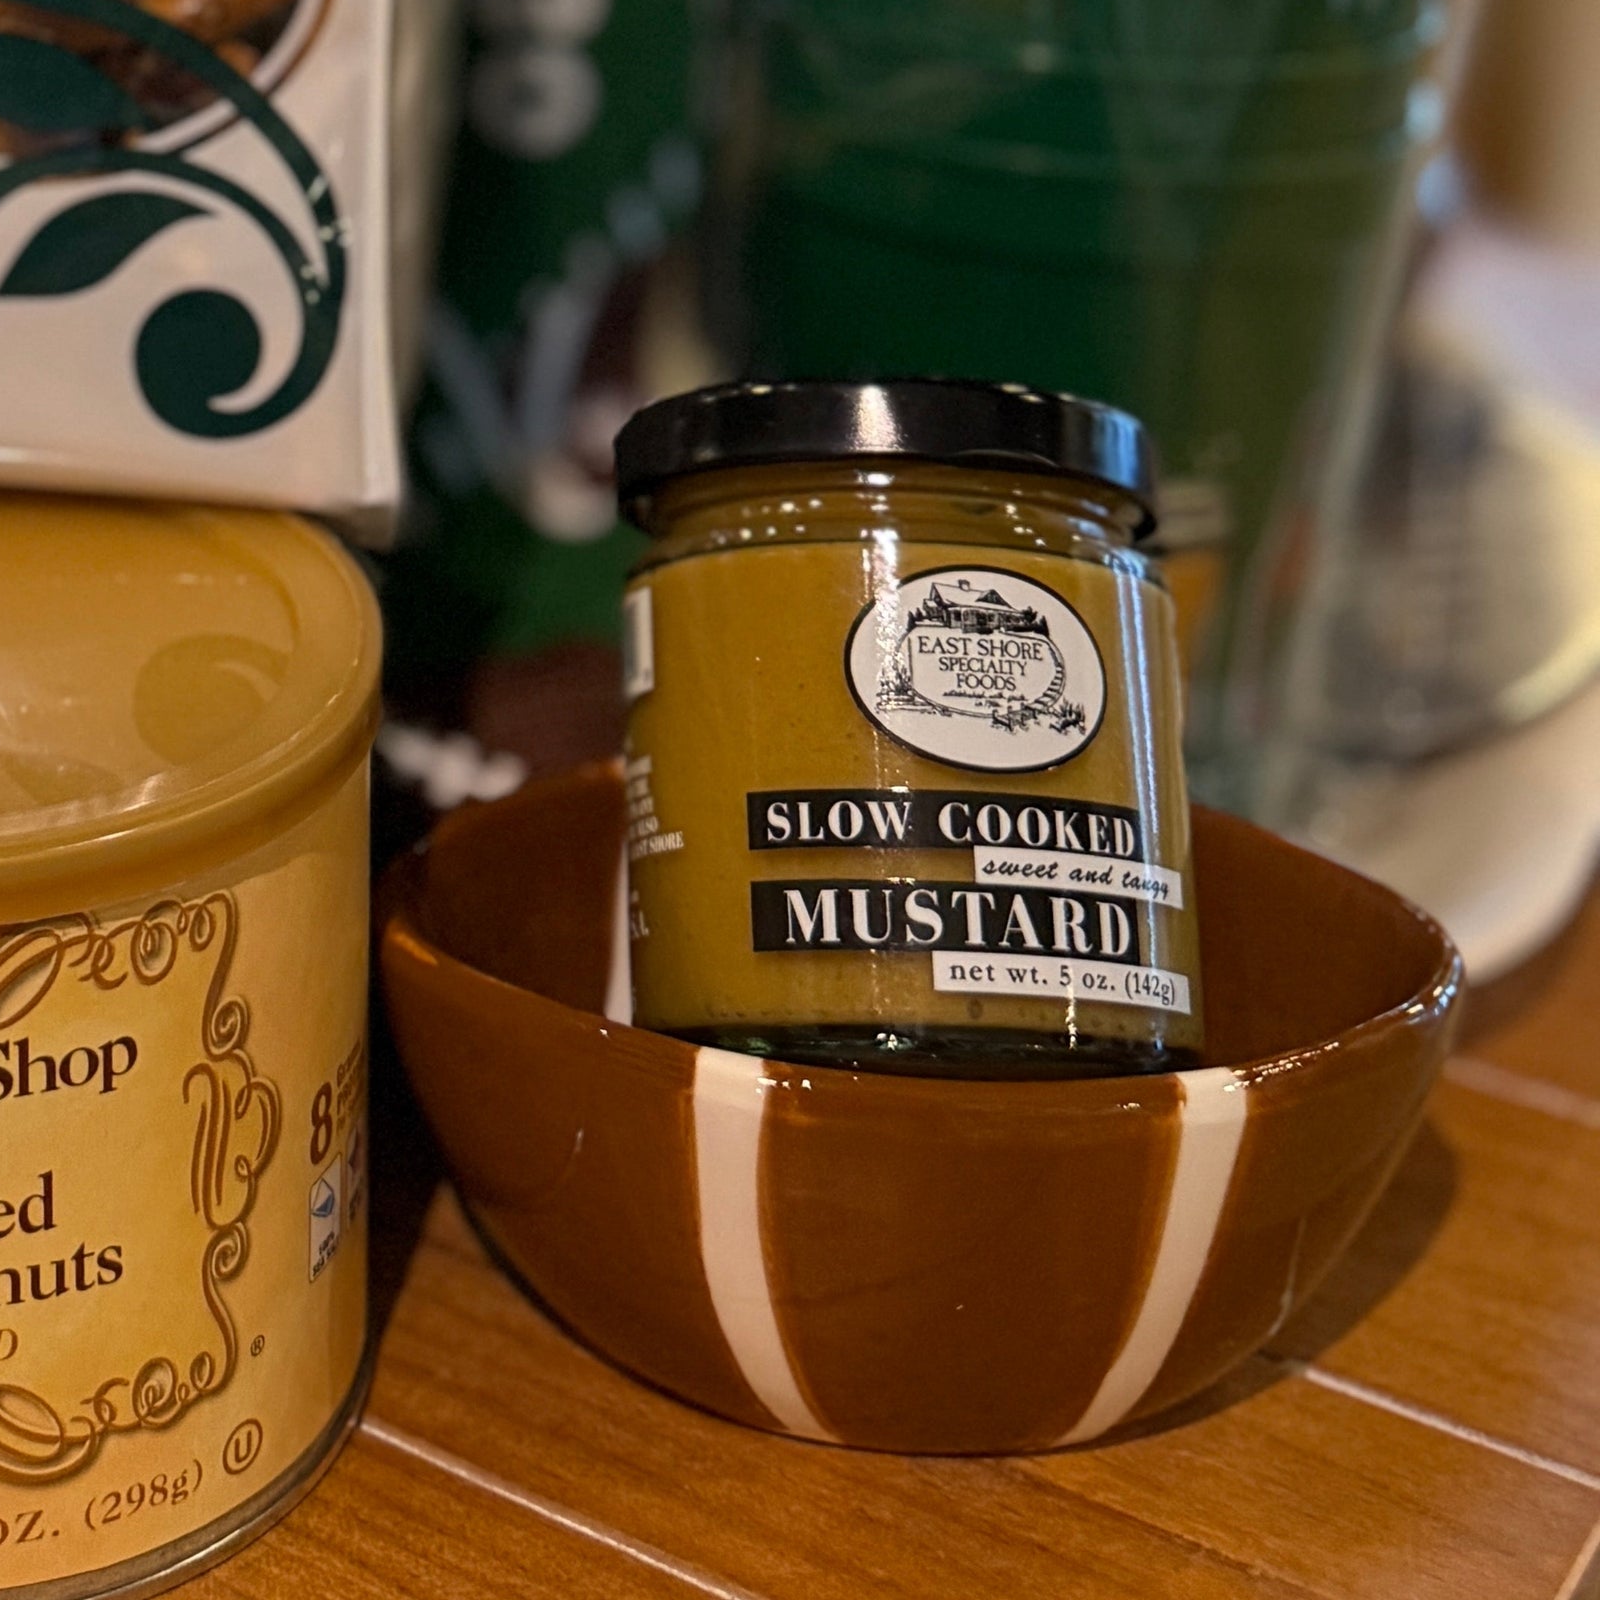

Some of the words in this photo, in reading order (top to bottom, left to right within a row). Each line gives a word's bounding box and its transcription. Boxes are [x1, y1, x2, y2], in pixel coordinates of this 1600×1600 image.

[918, 636, 972, 656] EAST
[977, 639, 1043, 661] SHORE
[939, 656, 1027, 676] SPECIALTY
[956, 673, 1016, 691] FOODS
[767, 800, 912, 841] SLOW
[938, 802, 1135, 858] COOKED
[982, 859, 1059, 880] sweet
[1069, 865, 1113, 886] and
[1122, 872, 1169, 900] tangy
[783, 888, 1131, 957] MUSTARD
[949, 963, 996, 981] net
[1006, 968, 1048, 985] wt.
[1059, 965, 1072, 986] 5
[1082, 973, 1116, 991] oz.
[1124, 970, 1176, 1006] (142g)
[310, 1081, 332, 1165] 8
[84, 1459, 203, 1531] (298g)
